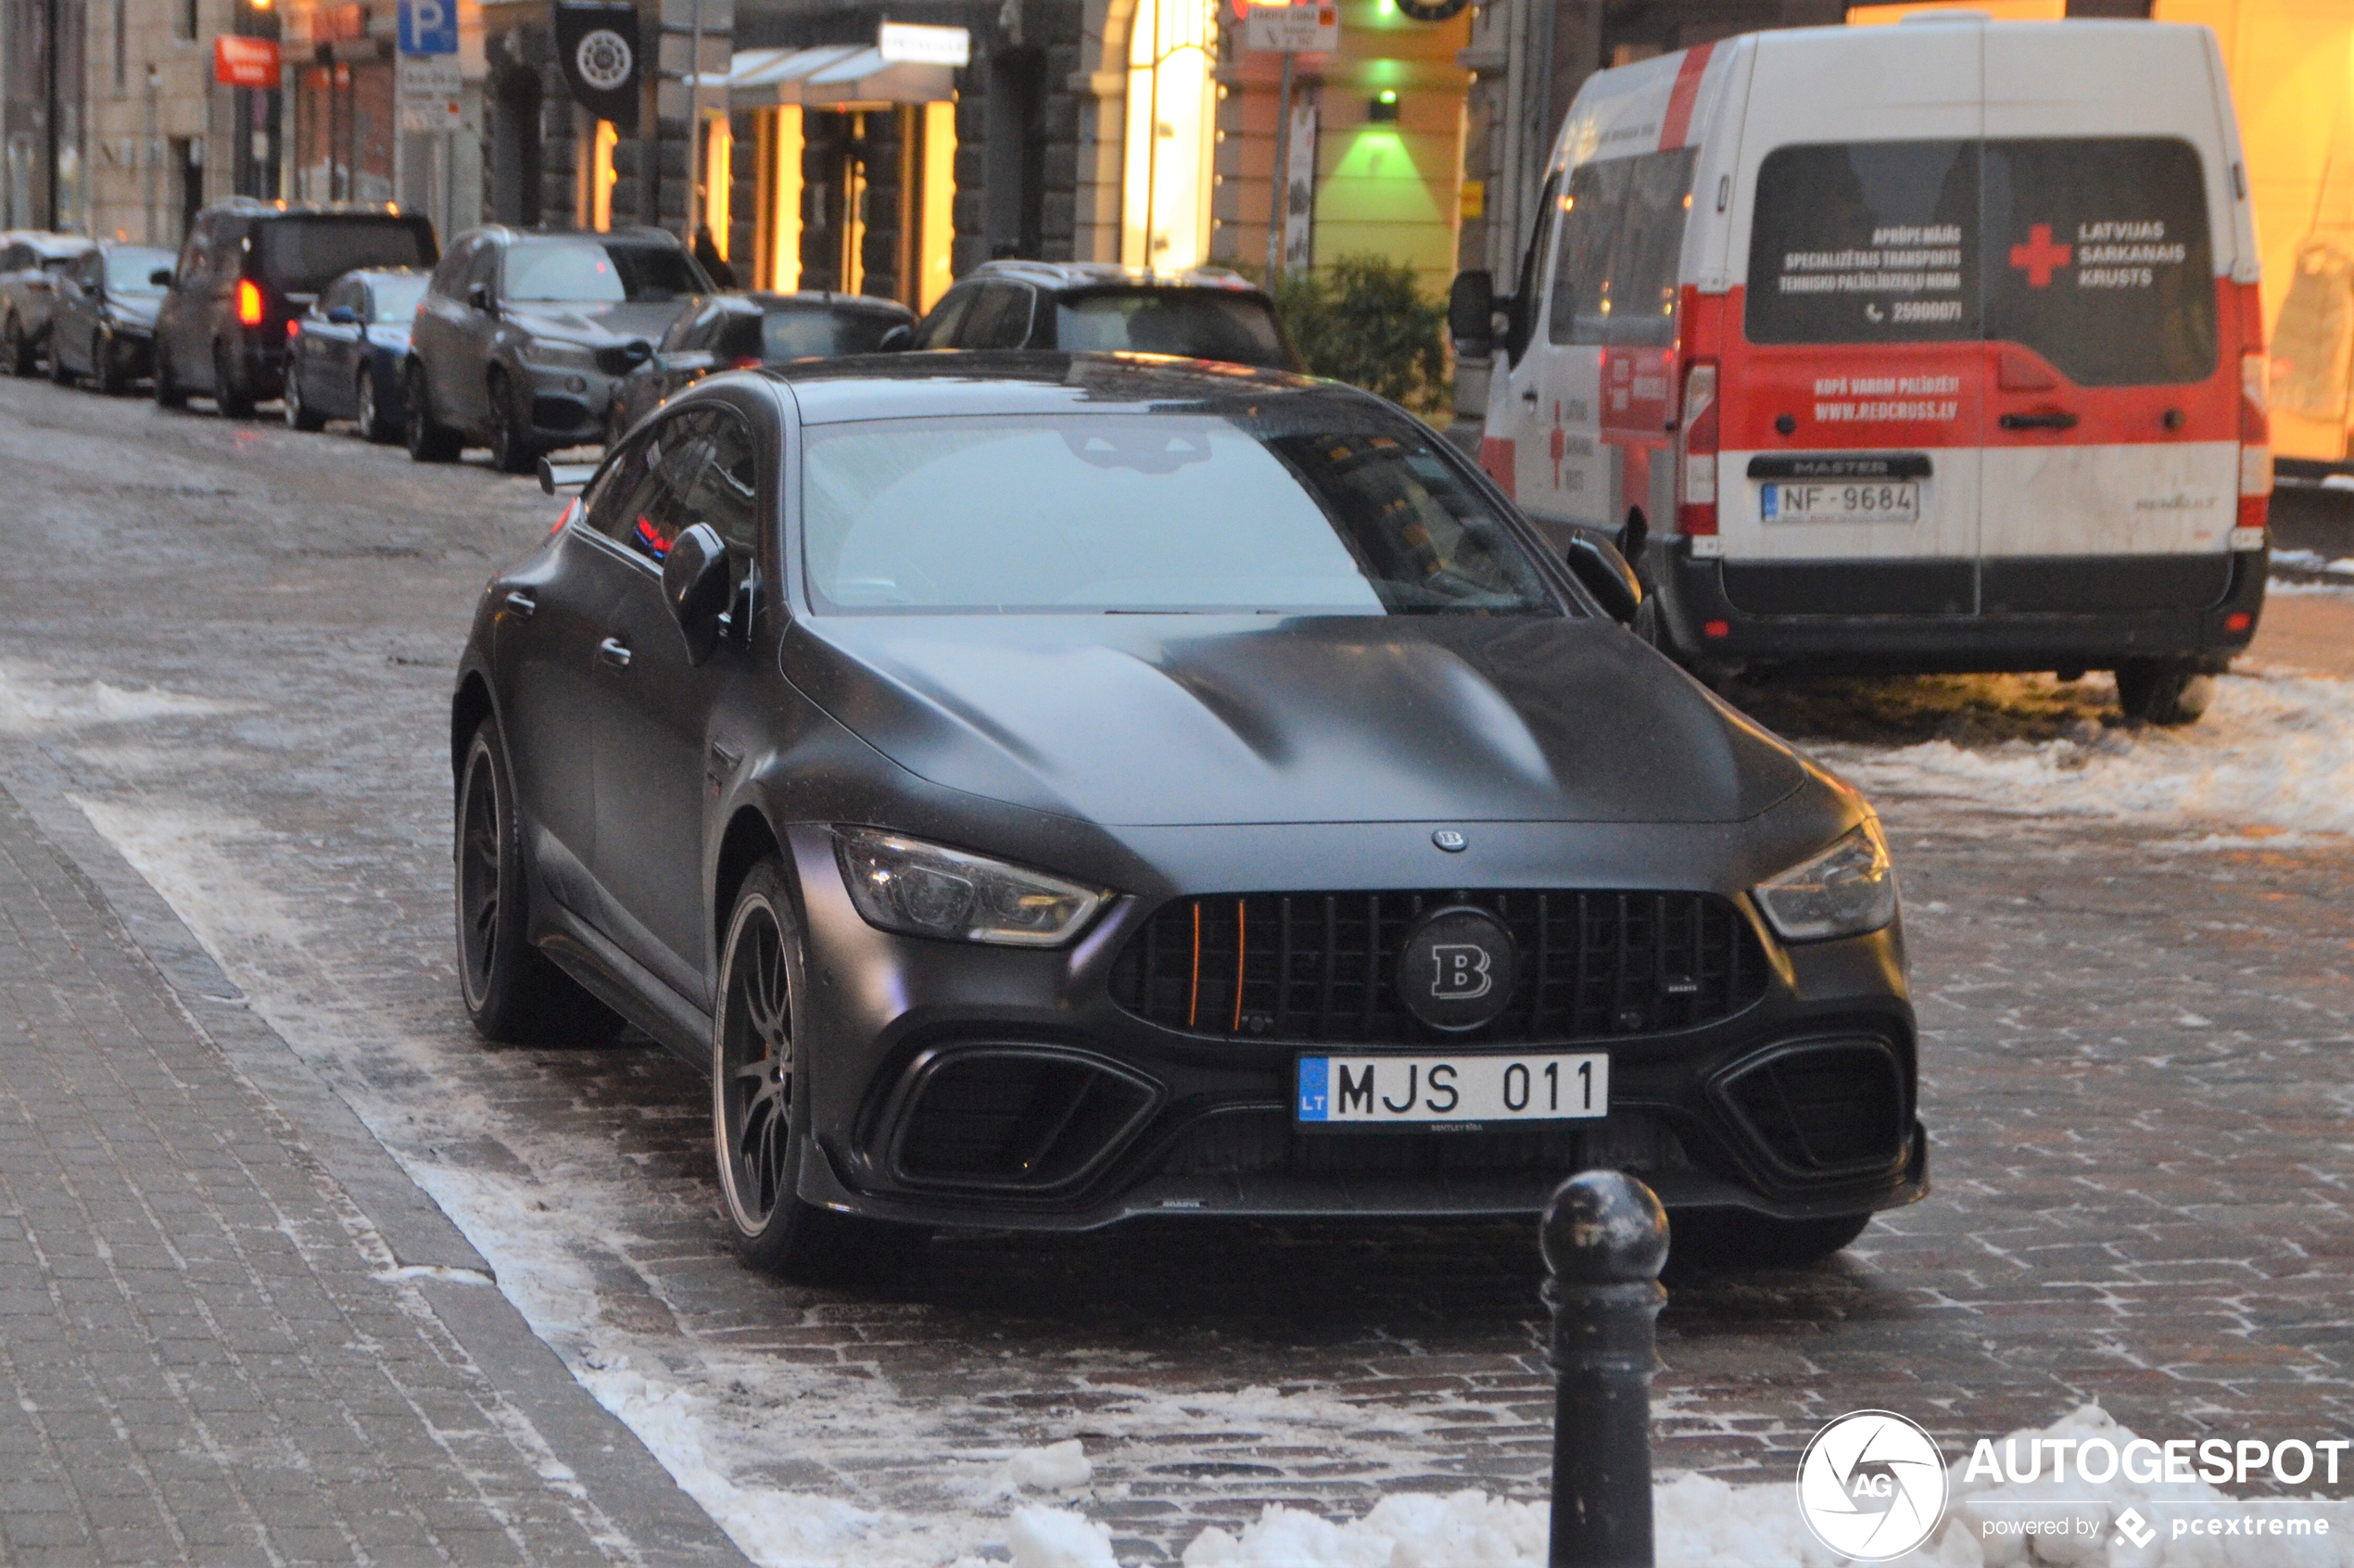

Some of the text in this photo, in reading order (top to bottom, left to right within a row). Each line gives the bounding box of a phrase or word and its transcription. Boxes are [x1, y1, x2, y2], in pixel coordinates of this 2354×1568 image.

[411, 0, 443, 48] P
[2079, 221, 2164, 241] LATVIJAS
[1882, 247, 1961, 268] TRANSPORTS
[2079, 243, 2185, 264] SARKANAIS
[1778, 274, 1837, 294] TEHNISKO
[2079, 268, 2152, 288] KRUSTS
[1816, 376, 1848, 395] KOPĀ
[1816, 401, 1958, 421] WWW.REDCROSS.LV
[1794, 462, 1888, 474] MASTER
[1431, 944, 1492, 999] B
[1338, 1061, 1592, 1114] MJS 011
[1302, 1096, 1324, 1111] LT
